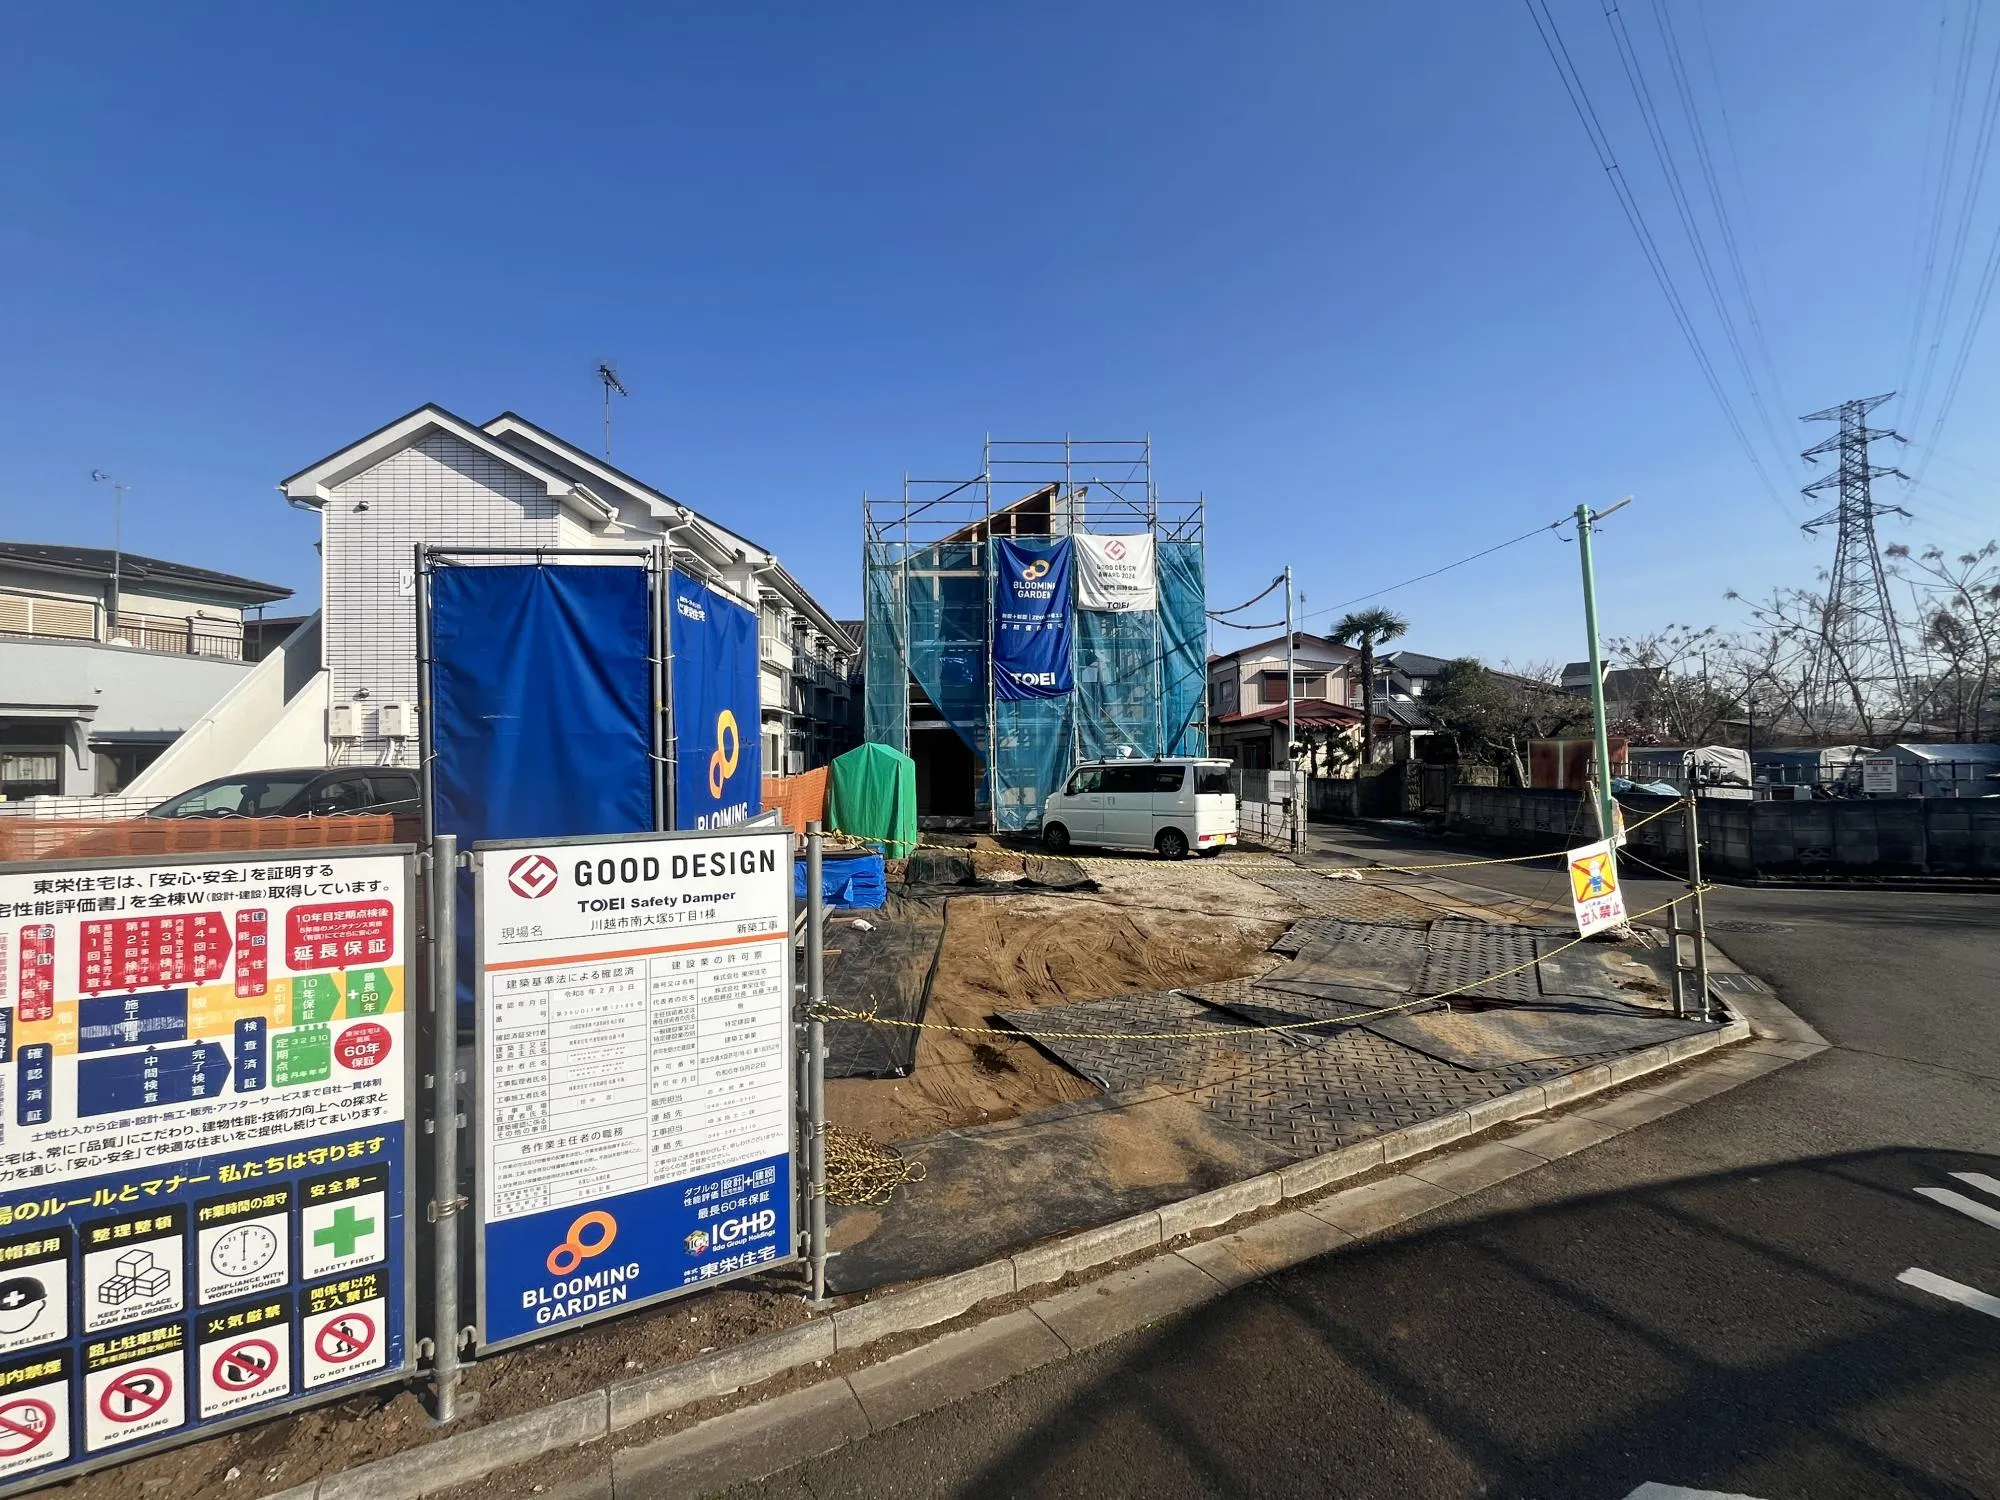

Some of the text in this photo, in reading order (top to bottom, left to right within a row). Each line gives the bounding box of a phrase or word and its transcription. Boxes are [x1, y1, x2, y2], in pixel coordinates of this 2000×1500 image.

[1114, 564, 1137, 572] DESIGN
[1013, 581, 1056, 590] BLOOMIN
[33, 864, 334, 895] 東栄住宅は、「安心・安全」を証明する
[574, 849, 776, 887] GOOD DESIGN
[631, 896, 678, 910] Safety
[682, 890, 736, 904] Damper
[295, 907, 389, 923] 10年目定期点検後
[591, 908, 716, 932] 川越市南大塚5丁目1棟
[1581, 901, 1621, 927] 立入禁止
[501, 924, 544, 939] 現場名
[736, 921, 778, 935] 新築工事
[86, 924, 101, 988] 第1回検査
[125, 921, 139, 984] 第2回検査
[159, 919, 173, 981] 第3回検査
[193, 916, 207, 977] 第4回検査
[293, 938, 387, 962] 延長保証
[671, 950, 763, 970] 建設業の許可票
[506, 966, 635, 990] 建築基準法による確認済
[496, 998, 547, 1010] 確認年月日
[124, 999, 139, 1042] 施工管理
[496, 1029, 547, 1042] 確認済証交付者
[243, 1020, 257, 1089] 検査済証
[275, 1038, 289, 1084] 定期点検
[344, 1042, 381, 1058] 60年
[351, 1055, 376, 1069] 保証
[26, 1047, 44, 1122] 確認済証
[143, 1055, 159, 1104] 中間検査
[191, 1049, 206, 1096] 完了検査
[651, 1109, 683, 1122] 連絡先
[521, 1126, 624, 1155] 各作業主任者の職務
[651, 1124, 683, 1138] 工事担当
[651, 1139, 683, 1153] 連絡先
[218, 1136, 386, 1184] 私たちは守ります
[310, 1175, 378, 1199] 安全第一
[684, 1181, 719, 1198] ダブルの
[723, 1176, 742, 1190] 設計
[198, 1191, 288, 1222] 作業時間の遵守
[683, 1190, 719, 1207] 性能評価
[697, 1190, 770, 1220] 最長60年保証
[91, 1214, 173, 1244] 整理整頓
[0, 1237, 61, 1262] 帽着用
[726, 1236, 748, 1249] Group
[313, 1255, 376, 1275] SAFETY FIRST
[699, 1245, 776, 1280] 東栄住宅
[204, 1271, 285, 1294] COMPLIANCE WITH
[207, 1278, 282, 1300] WORKING HOURS
[310, 1273, 377, 1301] 関係者以外
[522, 1262, 640, 1310] BLOOMING
[97, 1297, 172, 1320] KEEP THIS PLACE
[311, 1286, 378, 1313] 立入禁止
[535, 1285, 628, 1325] GARDEN
[89, 1302, 181, 1329] CLEAN AND ORDERLY
[208, 1304, 281, 1334] 火気厳禁
[10, 1331, 56, 1348] HELMET
[89, 1324, 182, 1359] 路上駐車禁止
[0, 1358, 62, 1387] 内禁煙
[313, 1358, 377, 1381] DO NOT ENTER
[204, 1384, 287, 1412] NO OPEN FLAMES
[104, 1417, 169, 1441] NO PARKING
[0, 1451, 54, 1471] SMOKING
